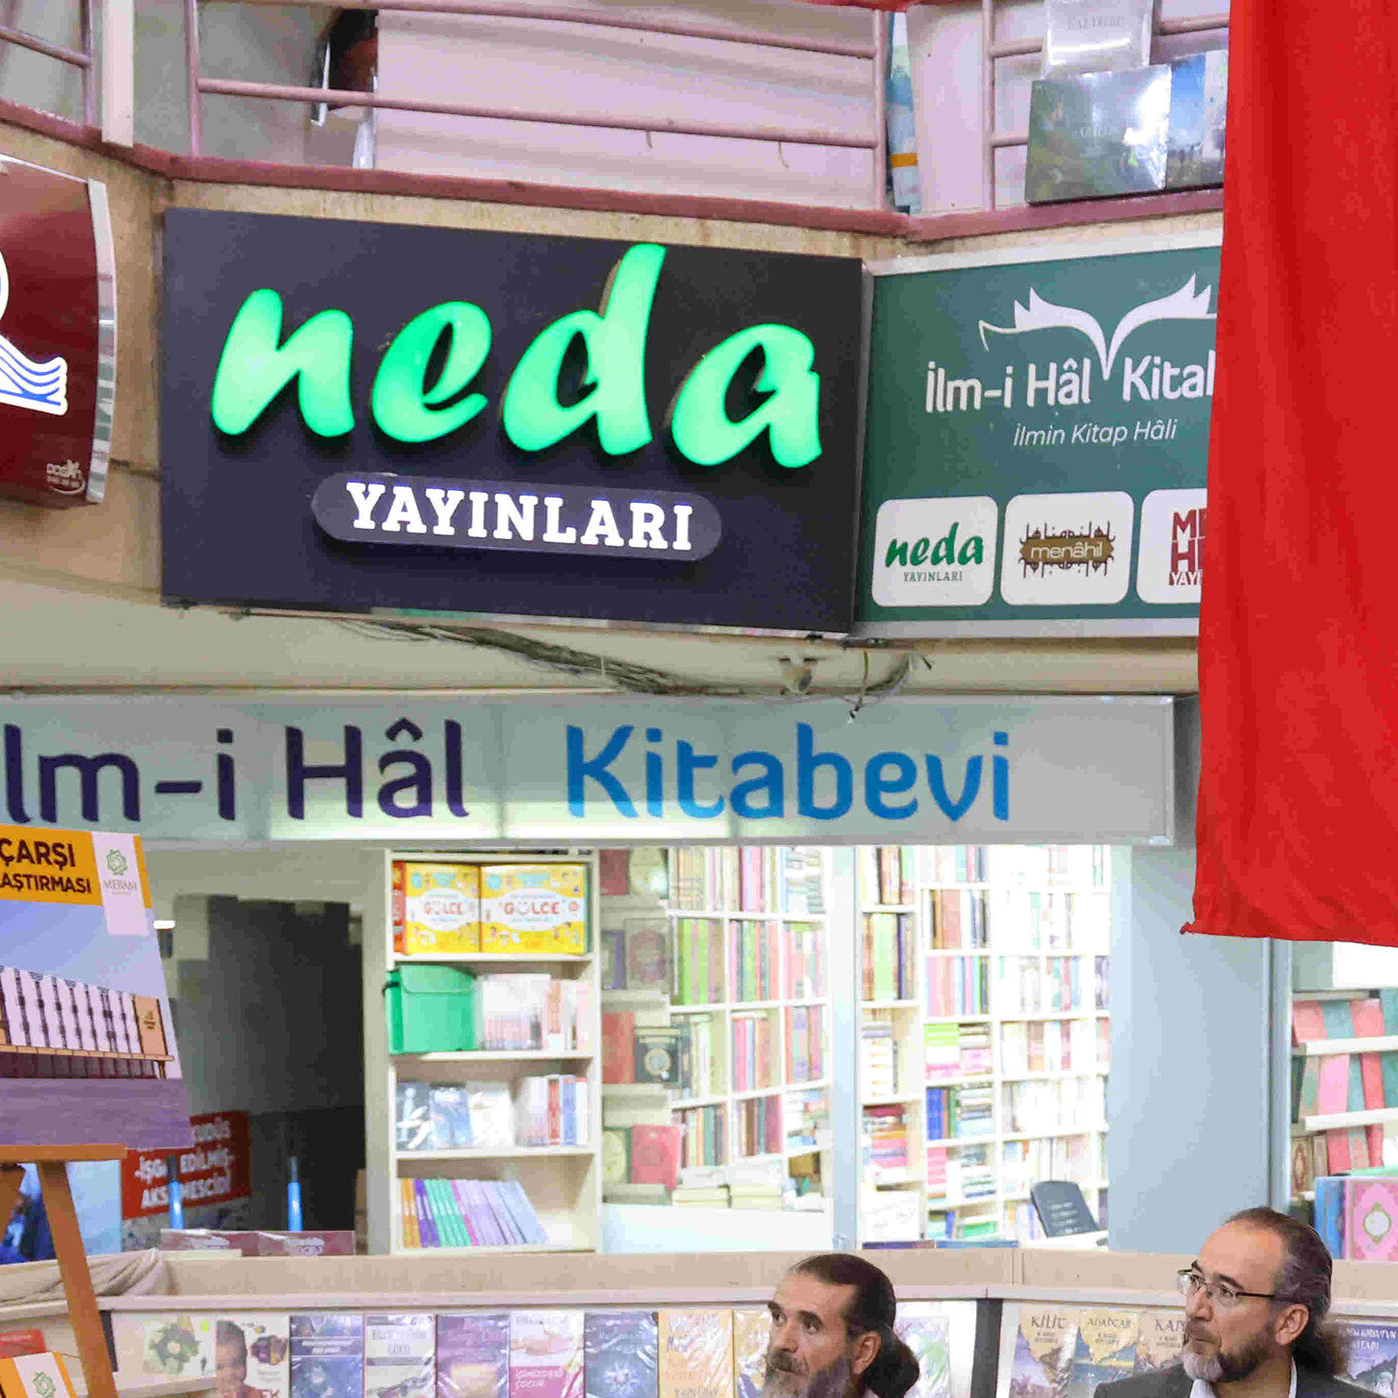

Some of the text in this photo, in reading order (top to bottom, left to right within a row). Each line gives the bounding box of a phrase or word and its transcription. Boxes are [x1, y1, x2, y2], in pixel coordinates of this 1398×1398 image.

[211, 243, 822, 467] neda
[926, 361, 1014, 413] İlm-i
[1027, 358, 1091, 407] Hâl
[1013, 418, 1177, 446] İlmin Kitap Hâli
[346, 482, 693, 551] YAYINLARI
[884, 521, 984, 568] neda
[903, 571, 963, 583] YAYINLARI
[288, 719, 471, 821] Hâl
[566, 722, 1011, 823] Kitabevi
[103, 877, 138, 892] MERAM
